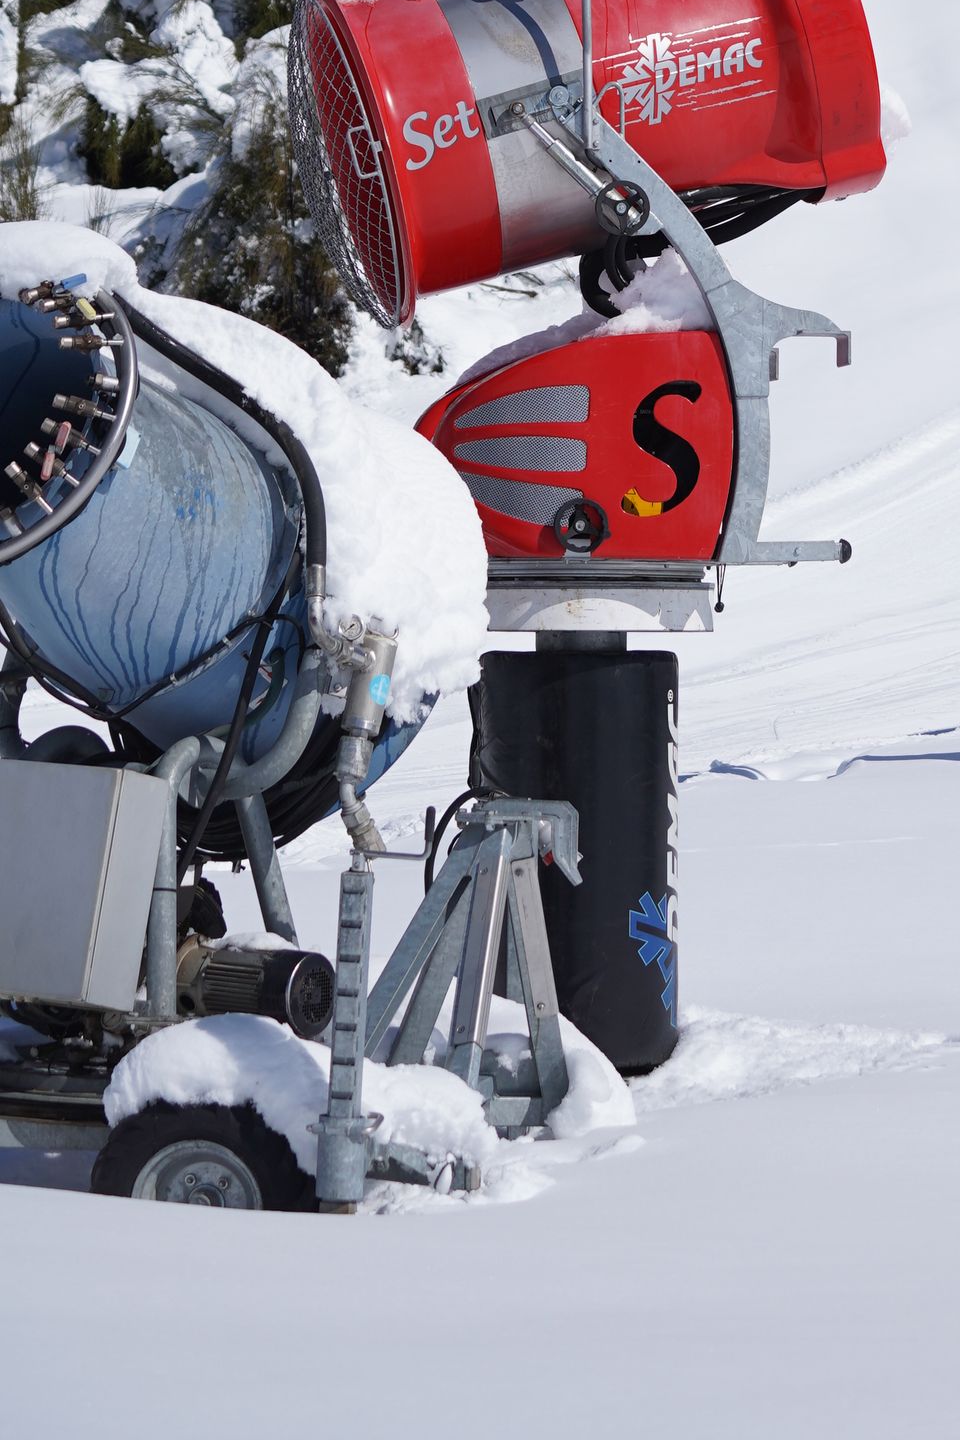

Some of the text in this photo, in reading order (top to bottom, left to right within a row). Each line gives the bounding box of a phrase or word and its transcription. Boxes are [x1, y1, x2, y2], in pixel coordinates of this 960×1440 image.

[655, 38, 763, 93] DEMAC
[402, 100, 480, 171] Set
[621, 379, 702, 517] S
